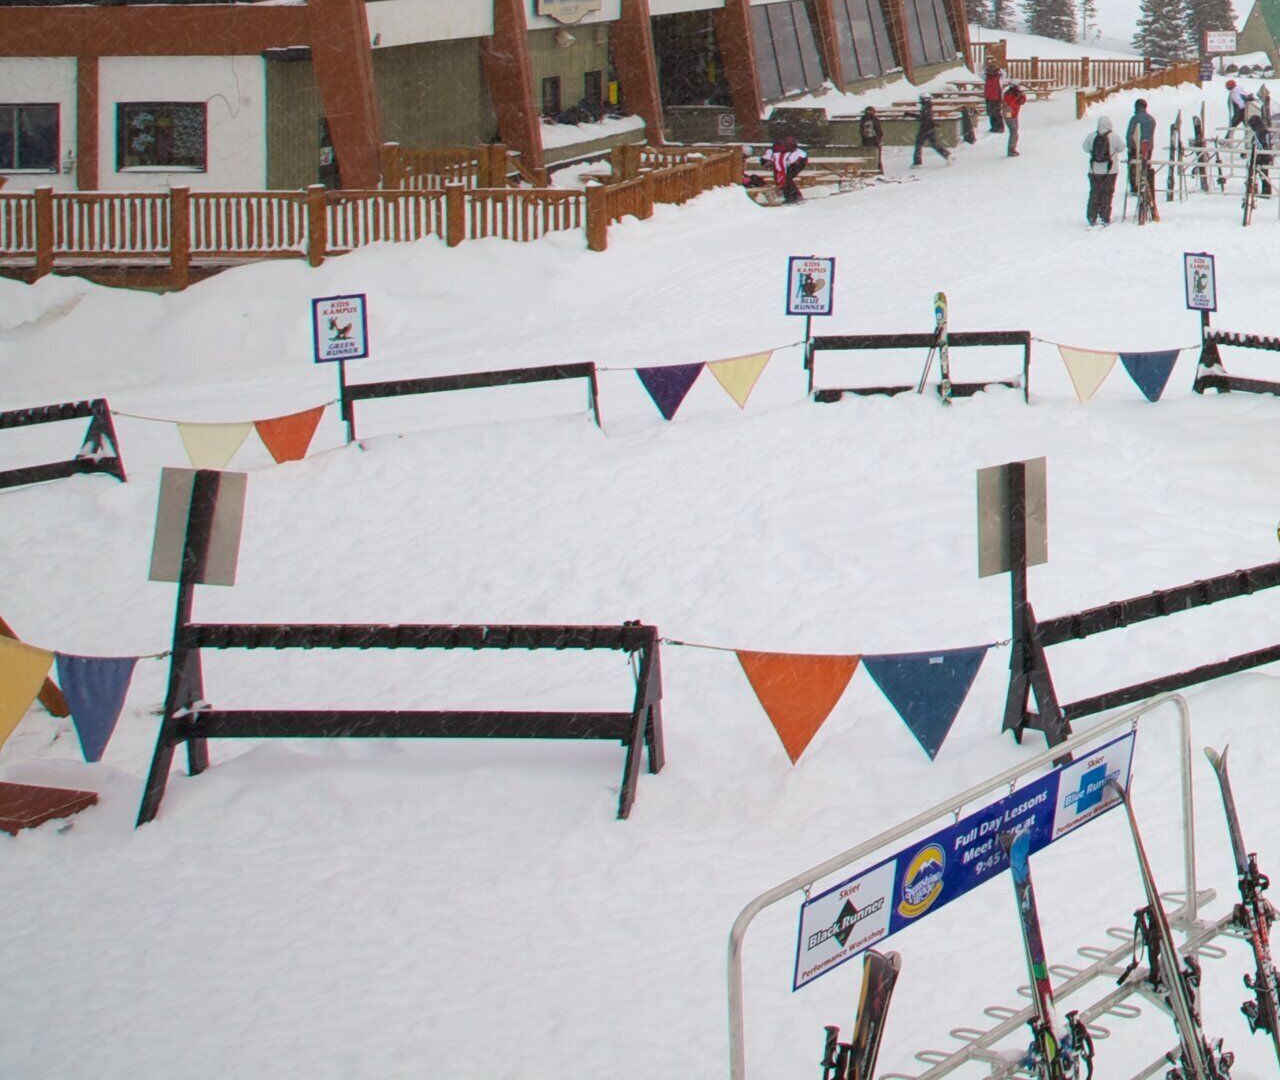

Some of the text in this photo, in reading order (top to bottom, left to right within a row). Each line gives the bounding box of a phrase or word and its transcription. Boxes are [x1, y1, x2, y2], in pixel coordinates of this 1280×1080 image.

[322, 306, 358, 316] KAMPUS
[330, 300, 349, 309] KIDS
[325, 347, 359, 357] RUNNER
[328, 341, 356, 350] GREEN
[1087, 755, 1105, 769] Skier
[1063, 789, 1086, 809] Blue
[954, 789, 1048, 851] Full Day Lessons
[1056, 809, 1093, 835] Performance
[962, 838, 993, 864] Meet
[1022, 813, 1036, 829] at
[975, 850, 1002, 876] 9:45
[838, 882, 861, 901] Skier
[807, 897, 885, 952] Black Runner
[801, 926, 885, 980] Performance Workshop
